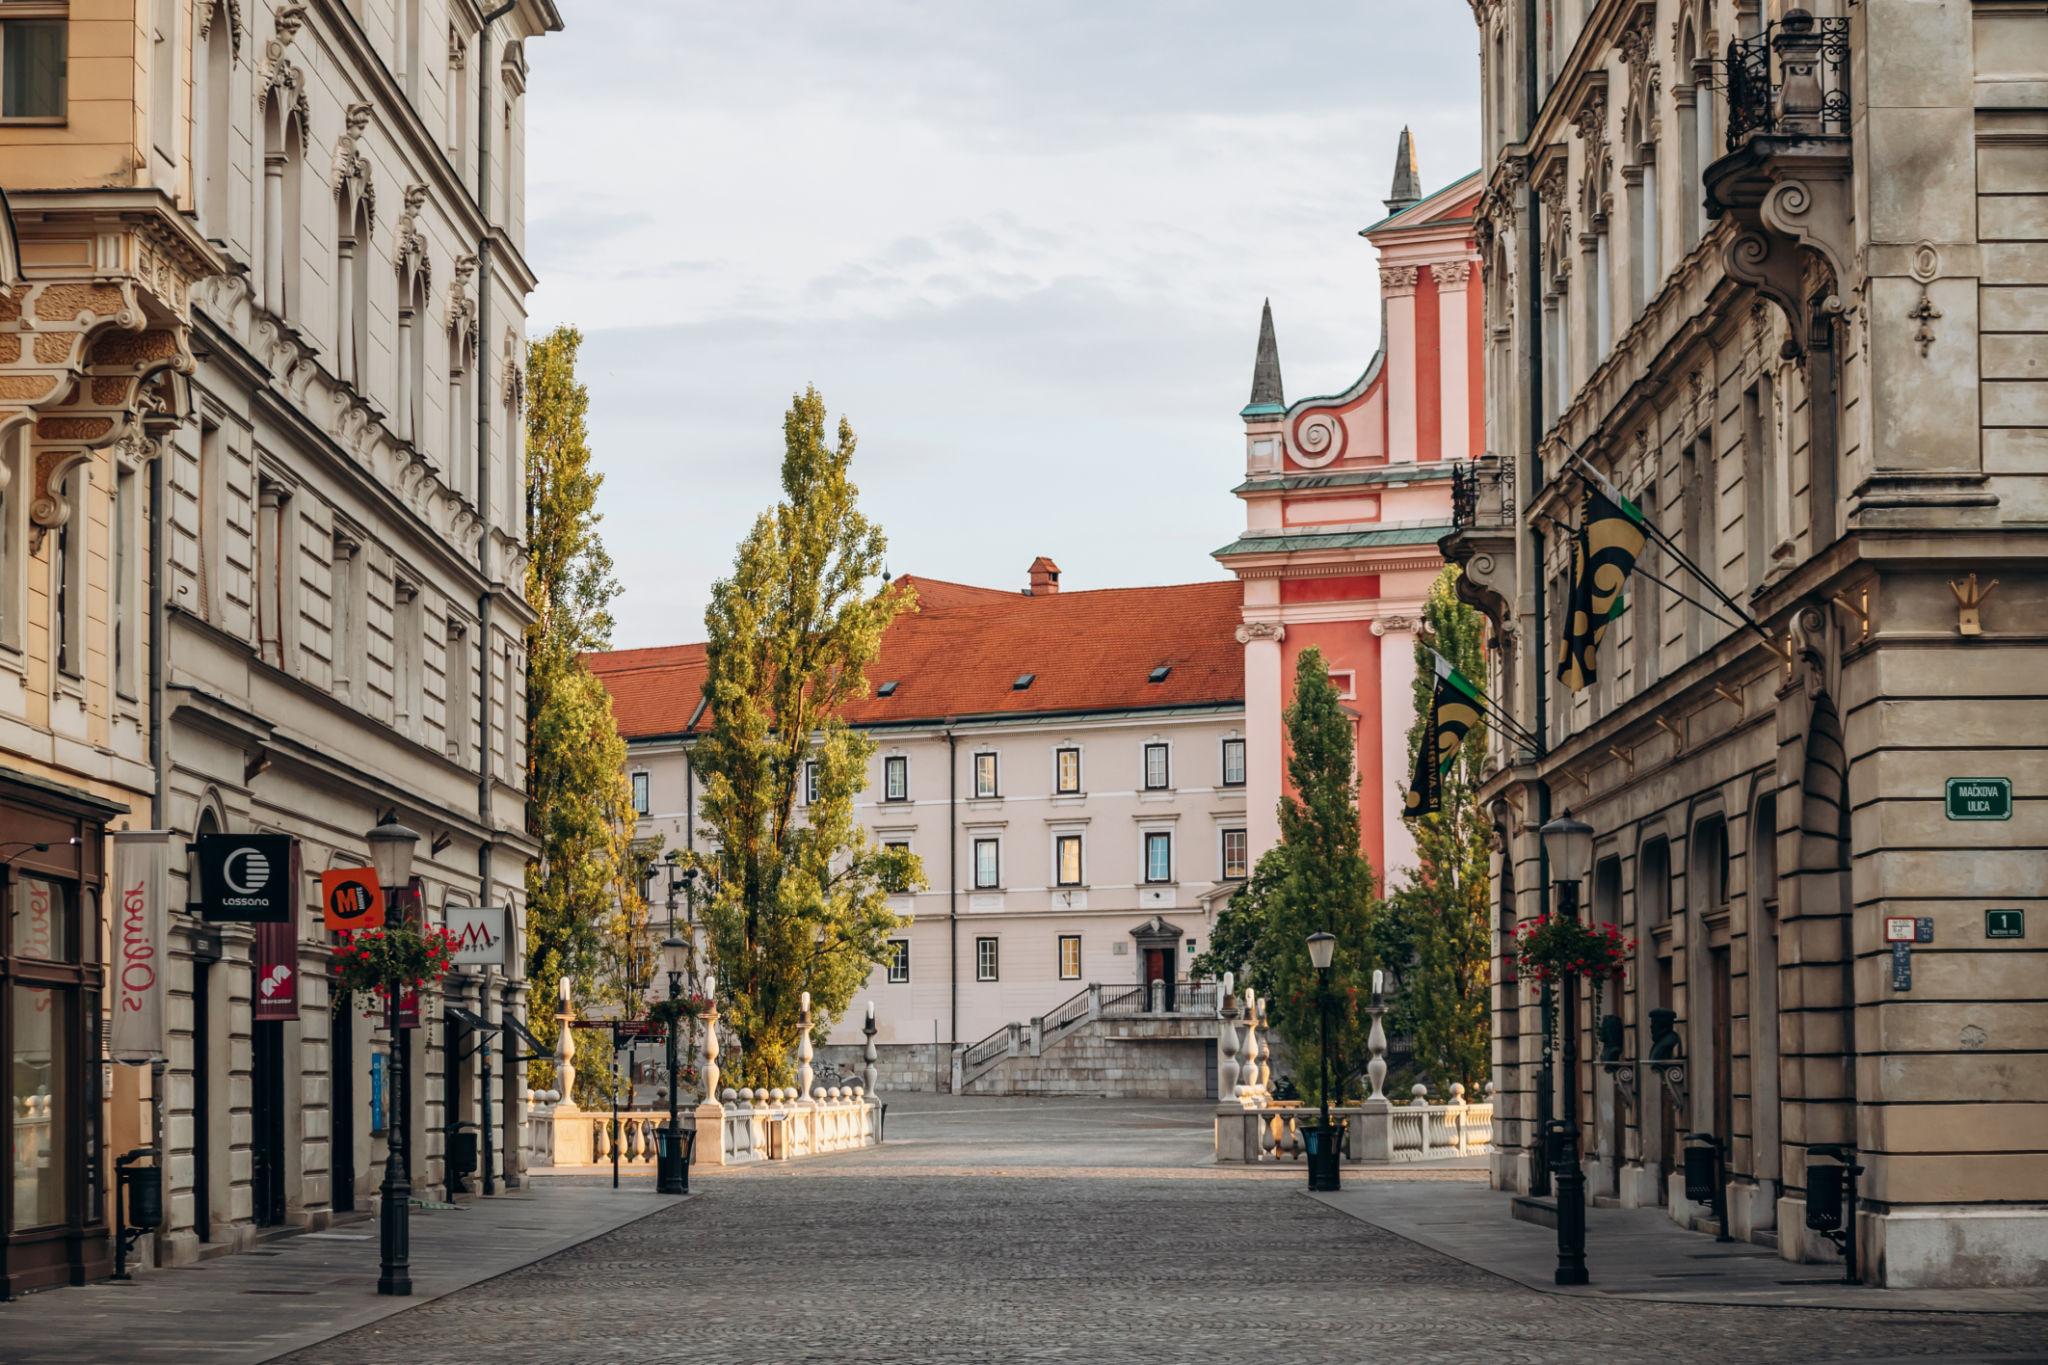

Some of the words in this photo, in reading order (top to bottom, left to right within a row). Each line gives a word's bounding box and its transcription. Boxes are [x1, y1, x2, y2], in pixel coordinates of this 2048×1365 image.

[1959, 784, 1998, 797] MAČKOVA
[1968, 801, 1990, 812] ULICA
[2001, 914, 2008, 928] 1
